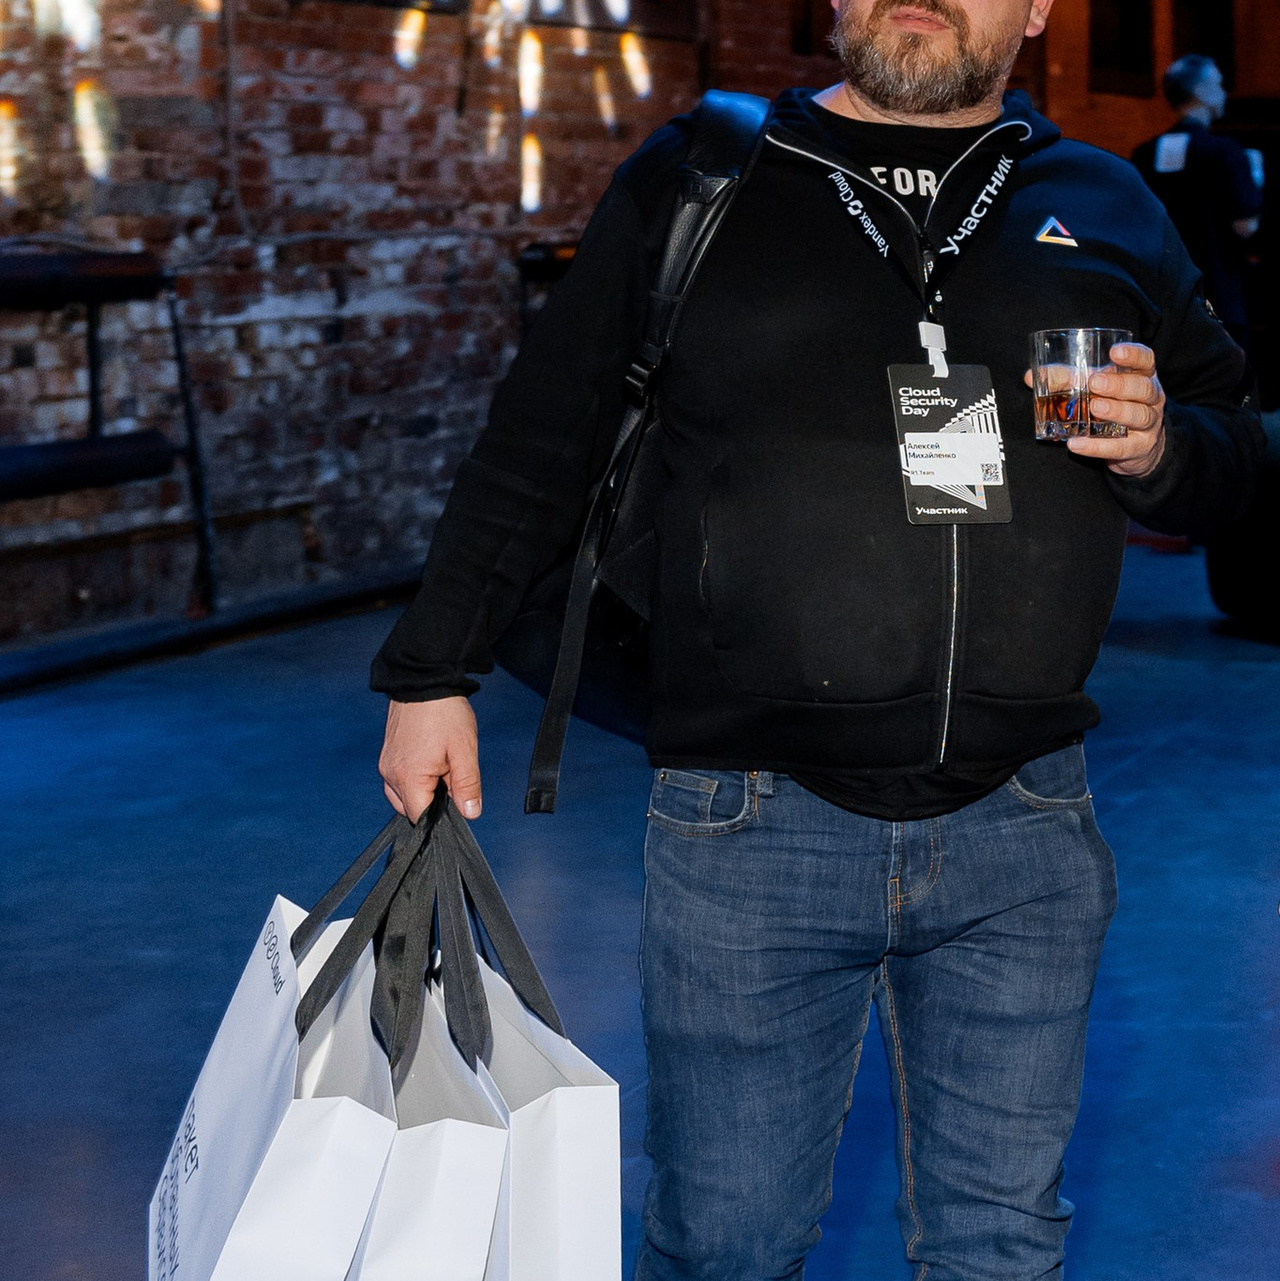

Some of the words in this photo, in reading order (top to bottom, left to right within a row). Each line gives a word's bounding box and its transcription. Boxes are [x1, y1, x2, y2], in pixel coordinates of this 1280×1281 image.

[828, 171, 854, 202] Cloud
[939, 154, 1014, 255] Участник
[858, 211, 890, 258] Yandex
[899, 387, 941, 396] Cloud
[900, 397, 958, 407] Security
[902, 406, 930, 417] Day
[907, 442, 940, 450] Алексей
[908, 451, 957, 459] Михайленко
[916, 507, 968, 516] Участник
